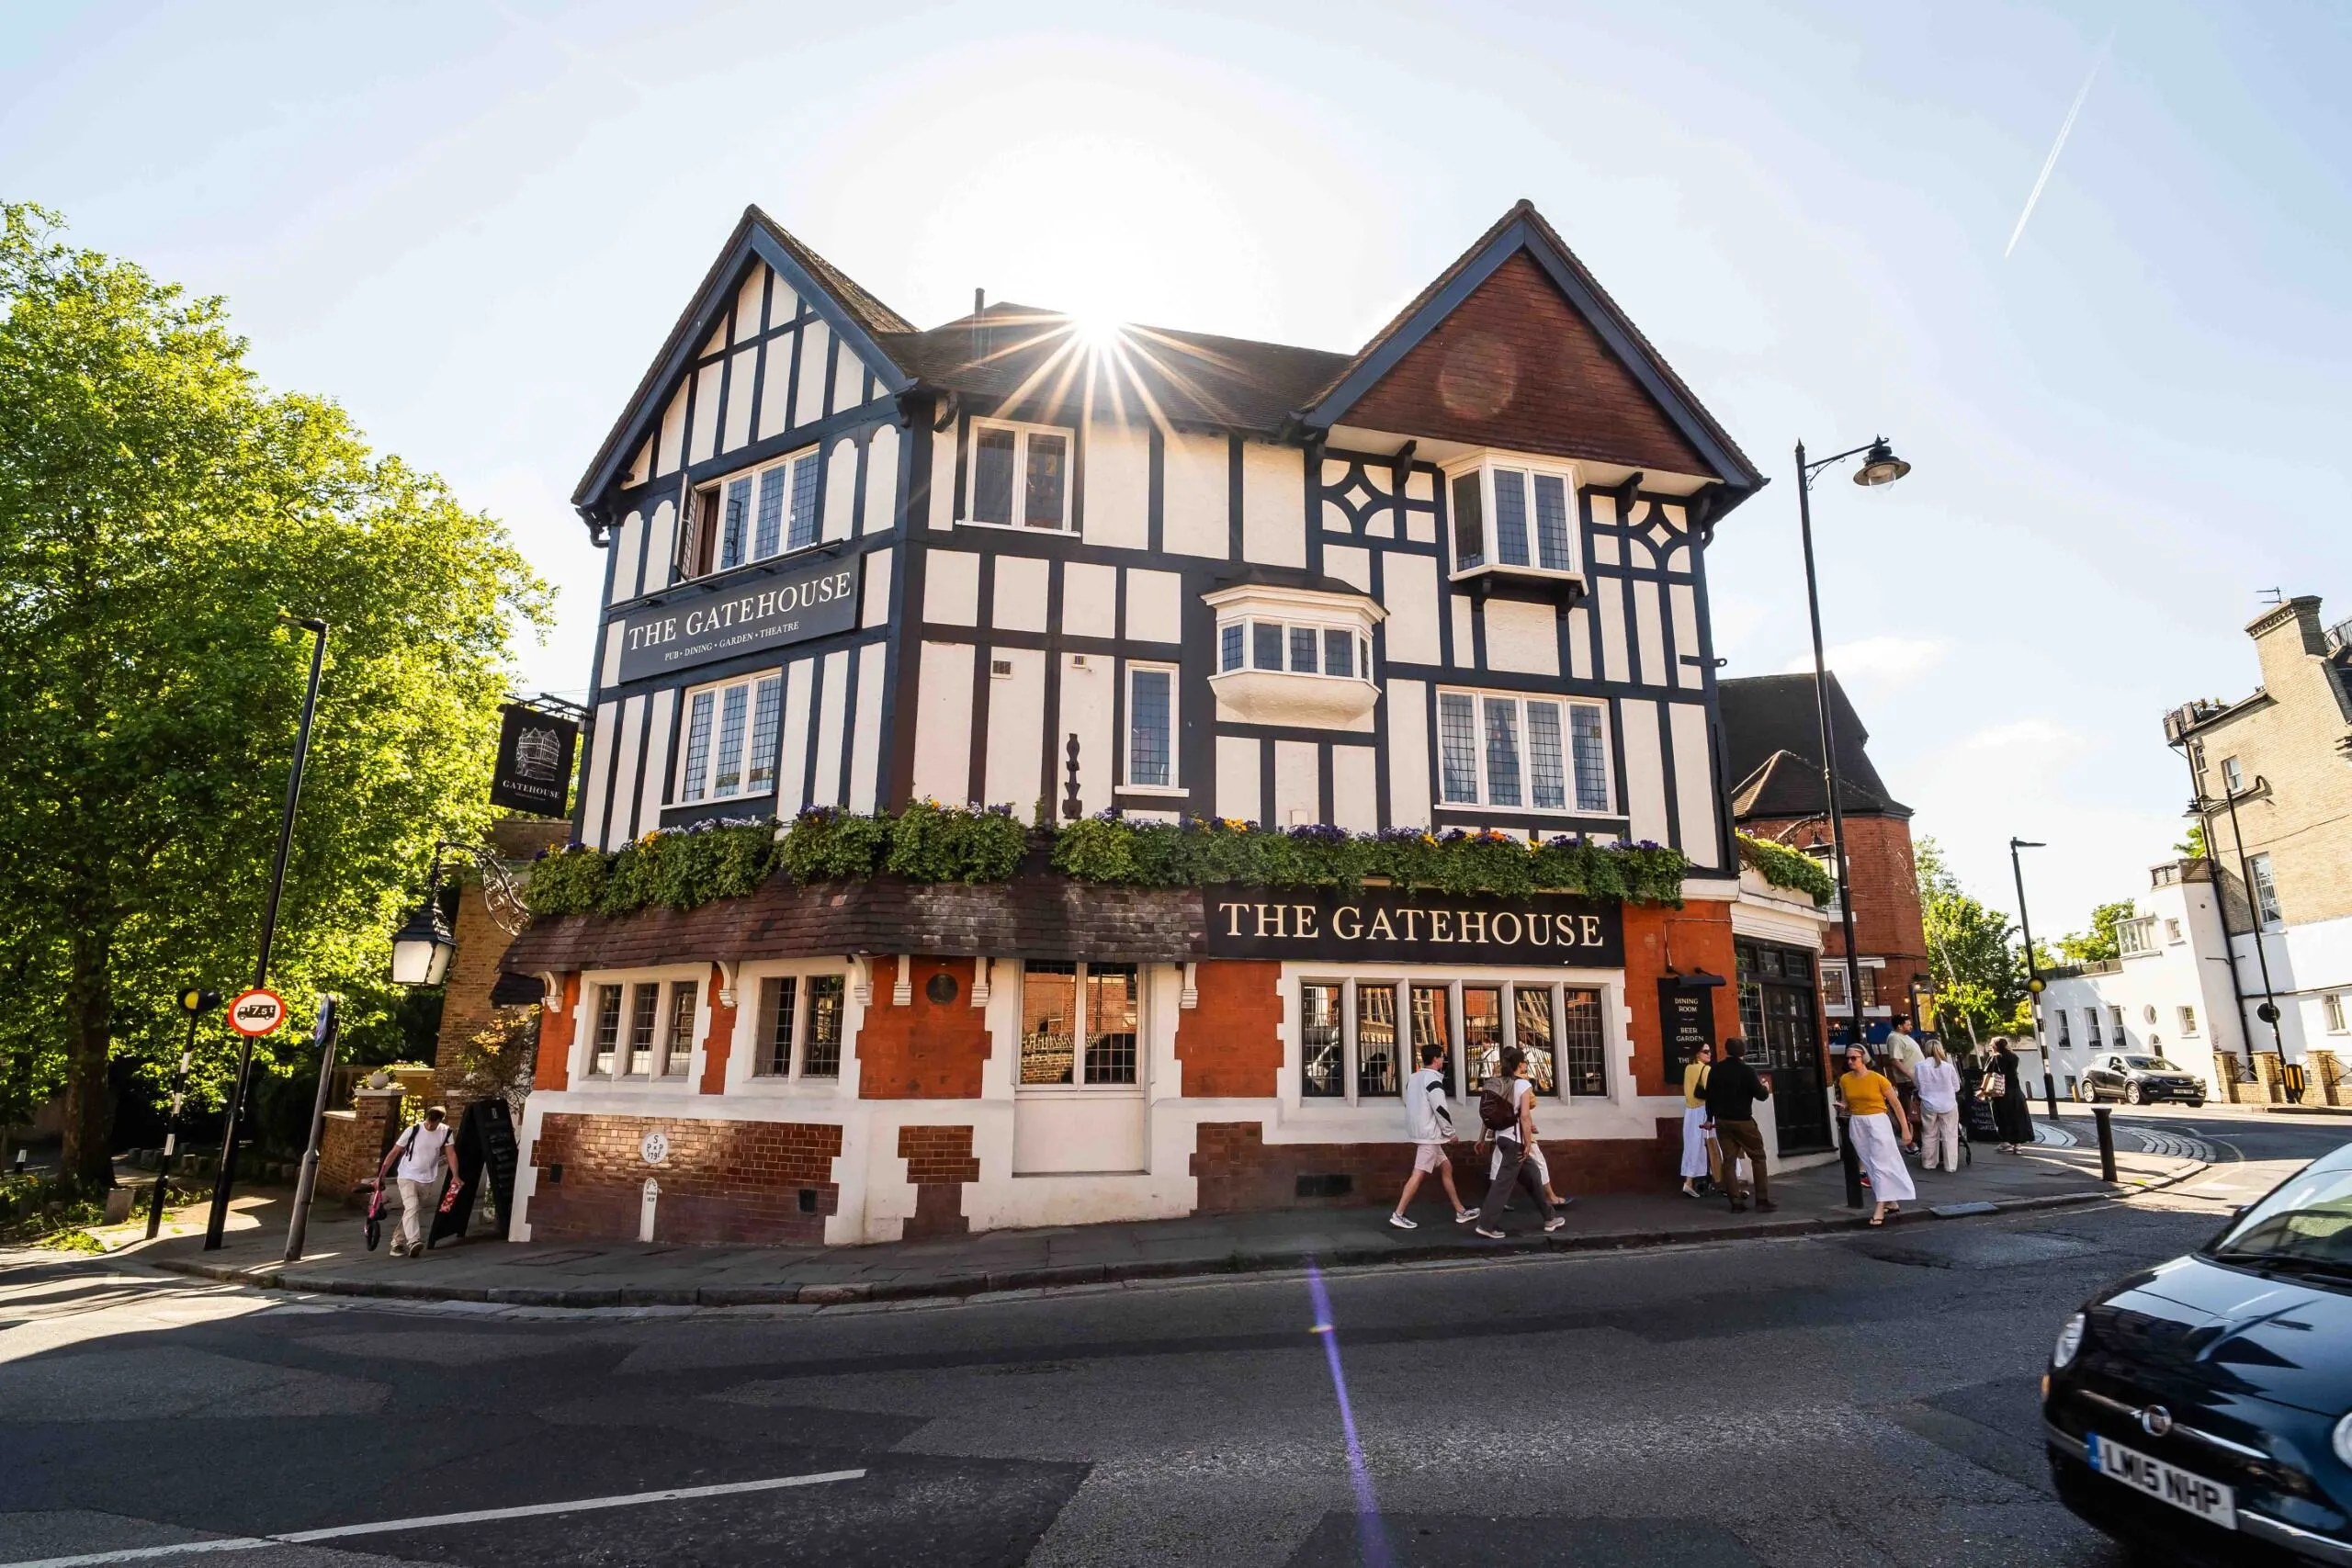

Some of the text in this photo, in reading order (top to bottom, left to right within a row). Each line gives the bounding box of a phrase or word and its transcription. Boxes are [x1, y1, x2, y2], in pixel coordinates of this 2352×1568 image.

[628, 571, 852, 650] THE GATEHOUSE
[664, 621, 800, 661] PUB DINING GARDEN THEATRE
[503, 780, 560, 799] GATEHOUSE
[1218, 902, 1604, 947] THE GATEHOUSE
[2164, 1470, 2221, 1514] NHP
